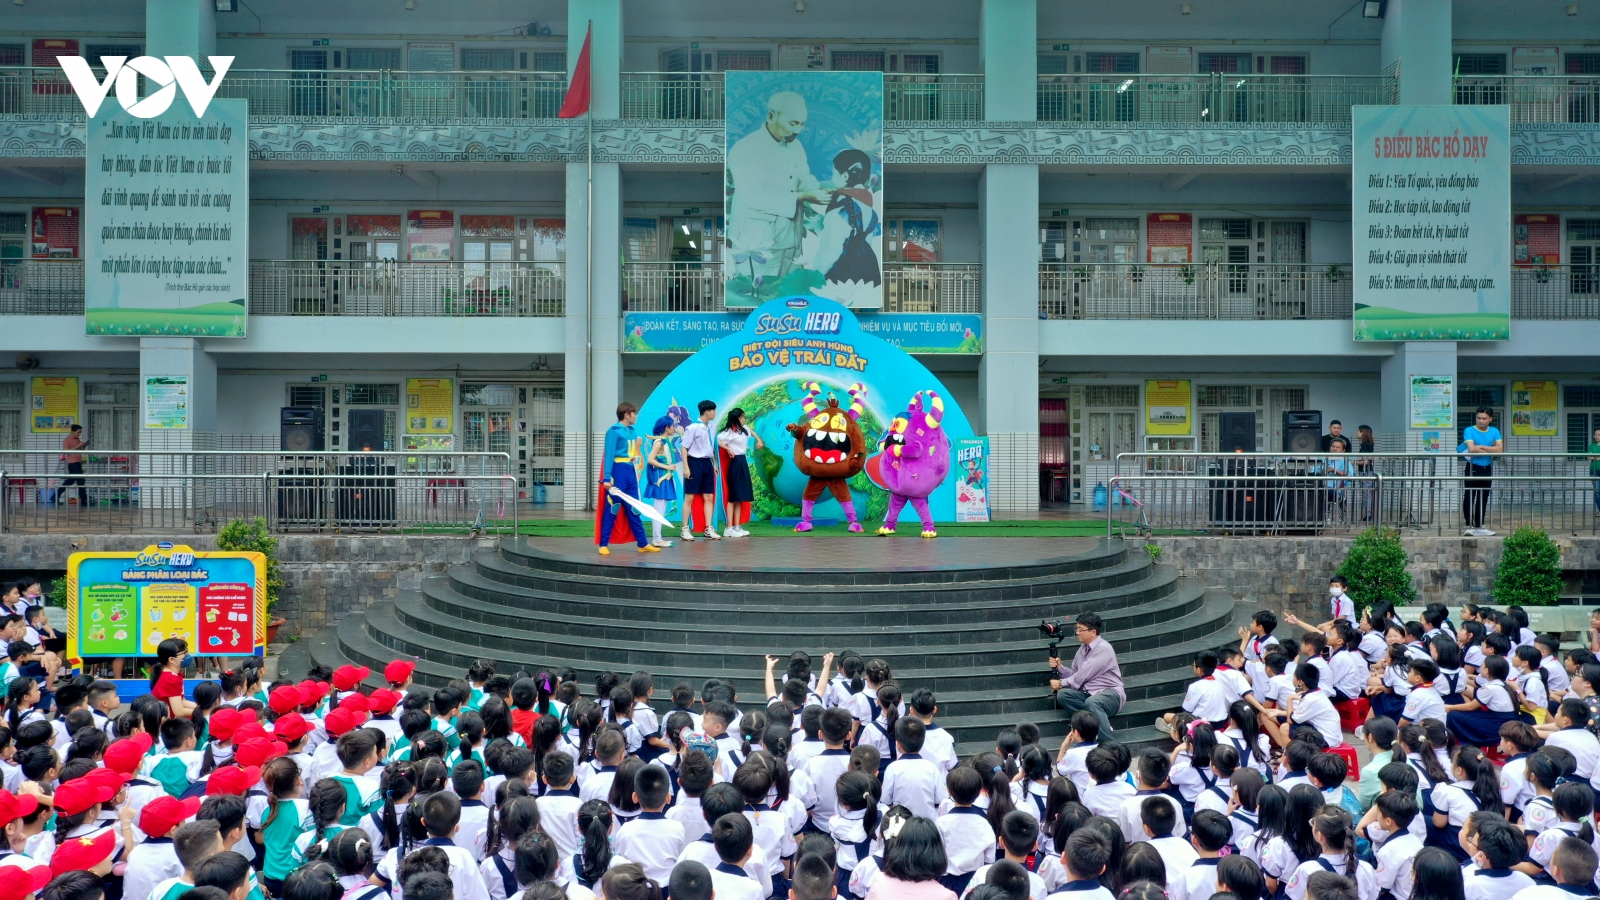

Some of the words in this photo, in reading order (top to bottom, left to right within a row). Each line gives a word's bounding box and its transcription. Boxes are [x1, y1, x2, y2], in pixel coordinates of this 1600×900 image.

[142, 121, 154, 143] Việt
[156, 122, 171, 139] Nam
[193, 122, 204, 140] nên
[220, 123, 232, 144] đẹp
[1375, 137, 1381, 158] 5
[1384, 128, 1412, 158] ĐIỀU
[1416, 130, 1440, 158] BÁC
[1443, 128, 1460, 158] HỒ
[1463, 136, 1488, 163] DẠY
[101, 154, 113, 176] hay
[139, 156, 151, 173] dân
[154, 155, 163, 177] tộc
[166, 156, 178, 177] Việt
[180, 156, 195, 173] Nam
[197, 156, 205, 174] có
[207, 156, 221, 174] bước
[1369, 172, 1384, 188] Điều
[1386, 174, 1392, 188] 1:
[1394, 174, 1406, 188] Yêu
[1417, 171, 1434, 191] quốc,
[1435, 174, 1448, 191] yêu
[1448, 172, 1466, 191] đồng
[1466, 174, 1480, 188] bào
[101, 187, 112, 206] đài
[114, 189, 128, 206] vinh
[130, 192, 149, 211] quang
[161, 188, 176, 207] sánh
[178, 189, 189, 207] vai
[201, 189, 212, 207] các
[213, 189, 232, 212] cường
[1369, 197, 1384, 213] Điều
[1385, 200, 1392, 213] 2:
[1394, 200, 1406, 216] Học
[1407, 200, 1419, 216] tập
[1419, 197, 1431, 214] tốt,
[1431, 200, 1443, 213] lao
[1443, 199, 1460, 216] động
[1461, 197, 1471, 213] tốt
[101, 217, 115, 244] quốc
[147, 222, 162, 244] được
[162, 222, 174, 245] hay
[195, 222, 212, 241] chính
[1369, 223, 1384, 239] Điều
[1385, 225, 1392, 239] 3:
[1394, 224, 1412, 239] Đoàn
[1412, 222, 1423, 239] kết
[1424, 222, 1435, 239] tốt,
[1445, 225, 1458, 242] luật
[1459, 222, 1469, 239] tốt
[161, 256, 173, 278] học
[173, 256, 184, 278] tập
[196, 255, 206, 274] các
[1369, 248, 1384, 264] Điều
[1385, 250, 1392, 264] 4:
[1394, 250, 1405, 264] Giữ
[1406, 249, 1418, 268] gìn
[1419, 250, 1426, 267] vệ
[1427, 250, 1442, 264] sinh
[1443, 250, 1457, 267] thật
[1458, 247, 1467, 264] tốt
[1369, 273, 1384, 289] Điều
[1385, 276, 1392, 289] 5:
[1416, 273, 1429, 290] tốn,
[1430, 275, 1445, 292] thật
[1445, 274, 1459, 290] thà,
[1460, 275, 1478, 292] dũng
[1479, 274, 1495, 289] cảm.
[666, 317, 681, 331] KẾT,
[683, 320, 702, 331] SÁNG
[704, 321, 718, 333] TẠO,
[720, 321, 730, 331] RA
[731, 320, 744, 331] SỨC
[804, 312, 842, 334] HERO
[860, 320, 880, 333] NHIỆM
[882, 322, 891, 333] VỤ
[893, 320, 902, 332] VÀ
[904, 322, 918, 333] MỤC
[920, 320, 935, 332] TIÊU
[937, 318, 948, 332] ĐỔI
[950, 320, 964, 332] MỚI,
[743, 342, 762, 354] BIỆT
[764, 340, 781, 350] ĐỘI
[784, 338, 804, 347] SIÊU
[806, 340, 826, 348] ANH
[828, 340, 854, 354] HÙNG
[729, 352, 764, 371] BẢO
[768, 349, 790, 366] VỆ
[793, 350, 831, 365] TRÁI
[835, 354, 867, 372] ĐẤT
[958, 445, 982, 461] HERO
[169, 553, 195, 567] HERO
